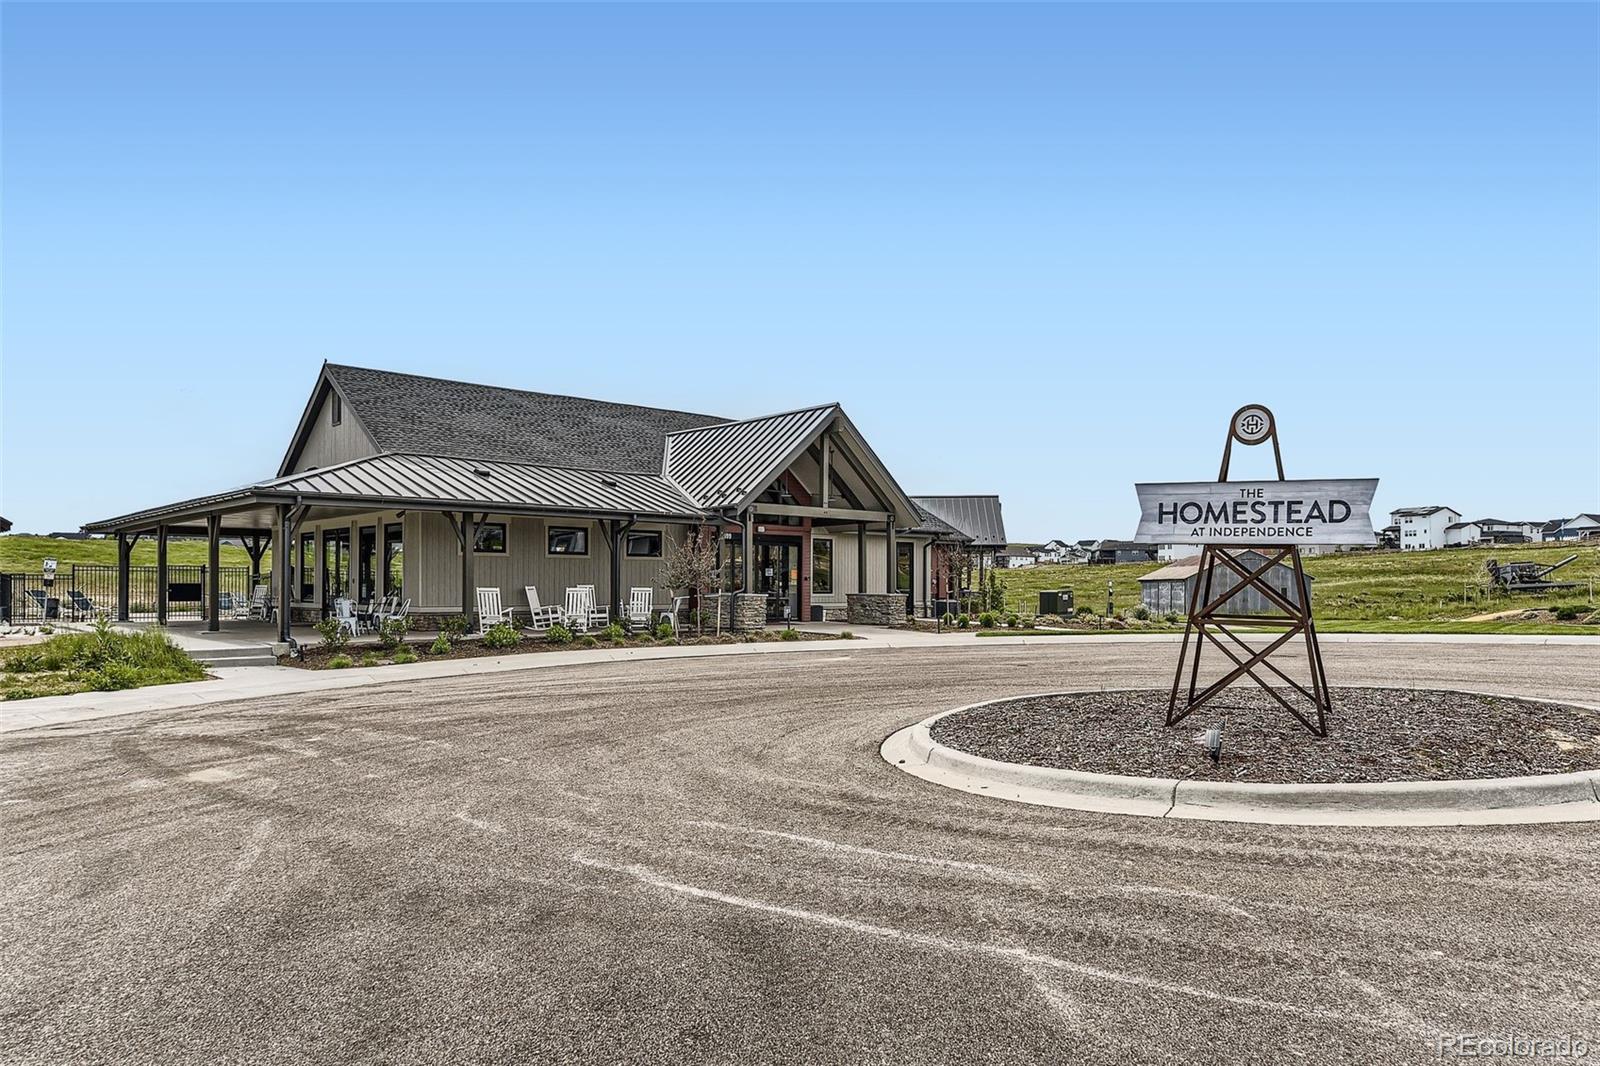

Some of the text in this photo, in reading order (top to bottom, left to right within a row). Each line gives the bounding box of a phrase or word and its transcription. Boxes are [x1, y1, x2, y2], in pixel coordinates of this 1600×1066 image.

[1239, 488, 1264, 498] THE
[1157, 500, 1352, 525] HOMESTEAD
[1190, 527, 1313, 537] AT INDEPENDENCE
